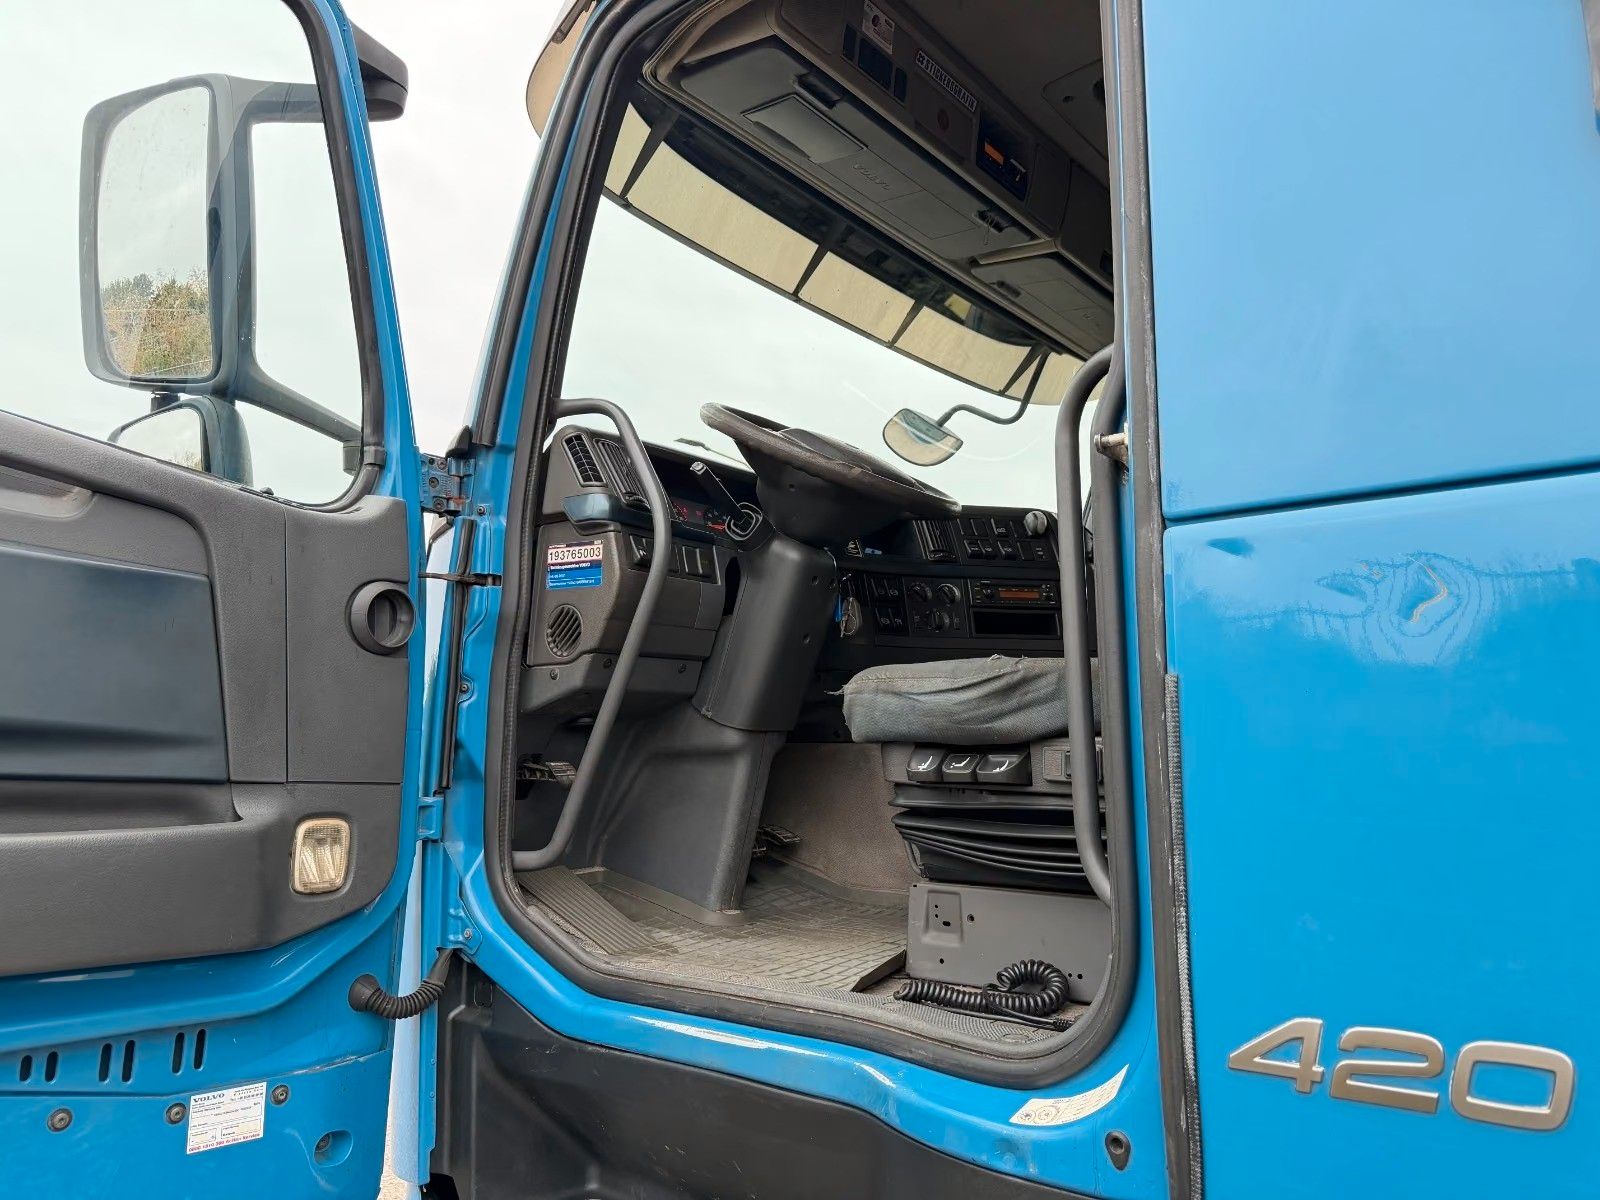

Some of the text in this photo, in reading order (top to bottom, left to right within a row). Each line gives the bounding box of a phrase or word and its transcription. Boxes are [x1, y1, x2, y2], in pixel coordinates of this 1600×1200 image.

[550, 547, 601, 561] 193765003
[1228, 1017, 1574, 1132] 420
[192, 1093, 225, 1103] VOLVO
